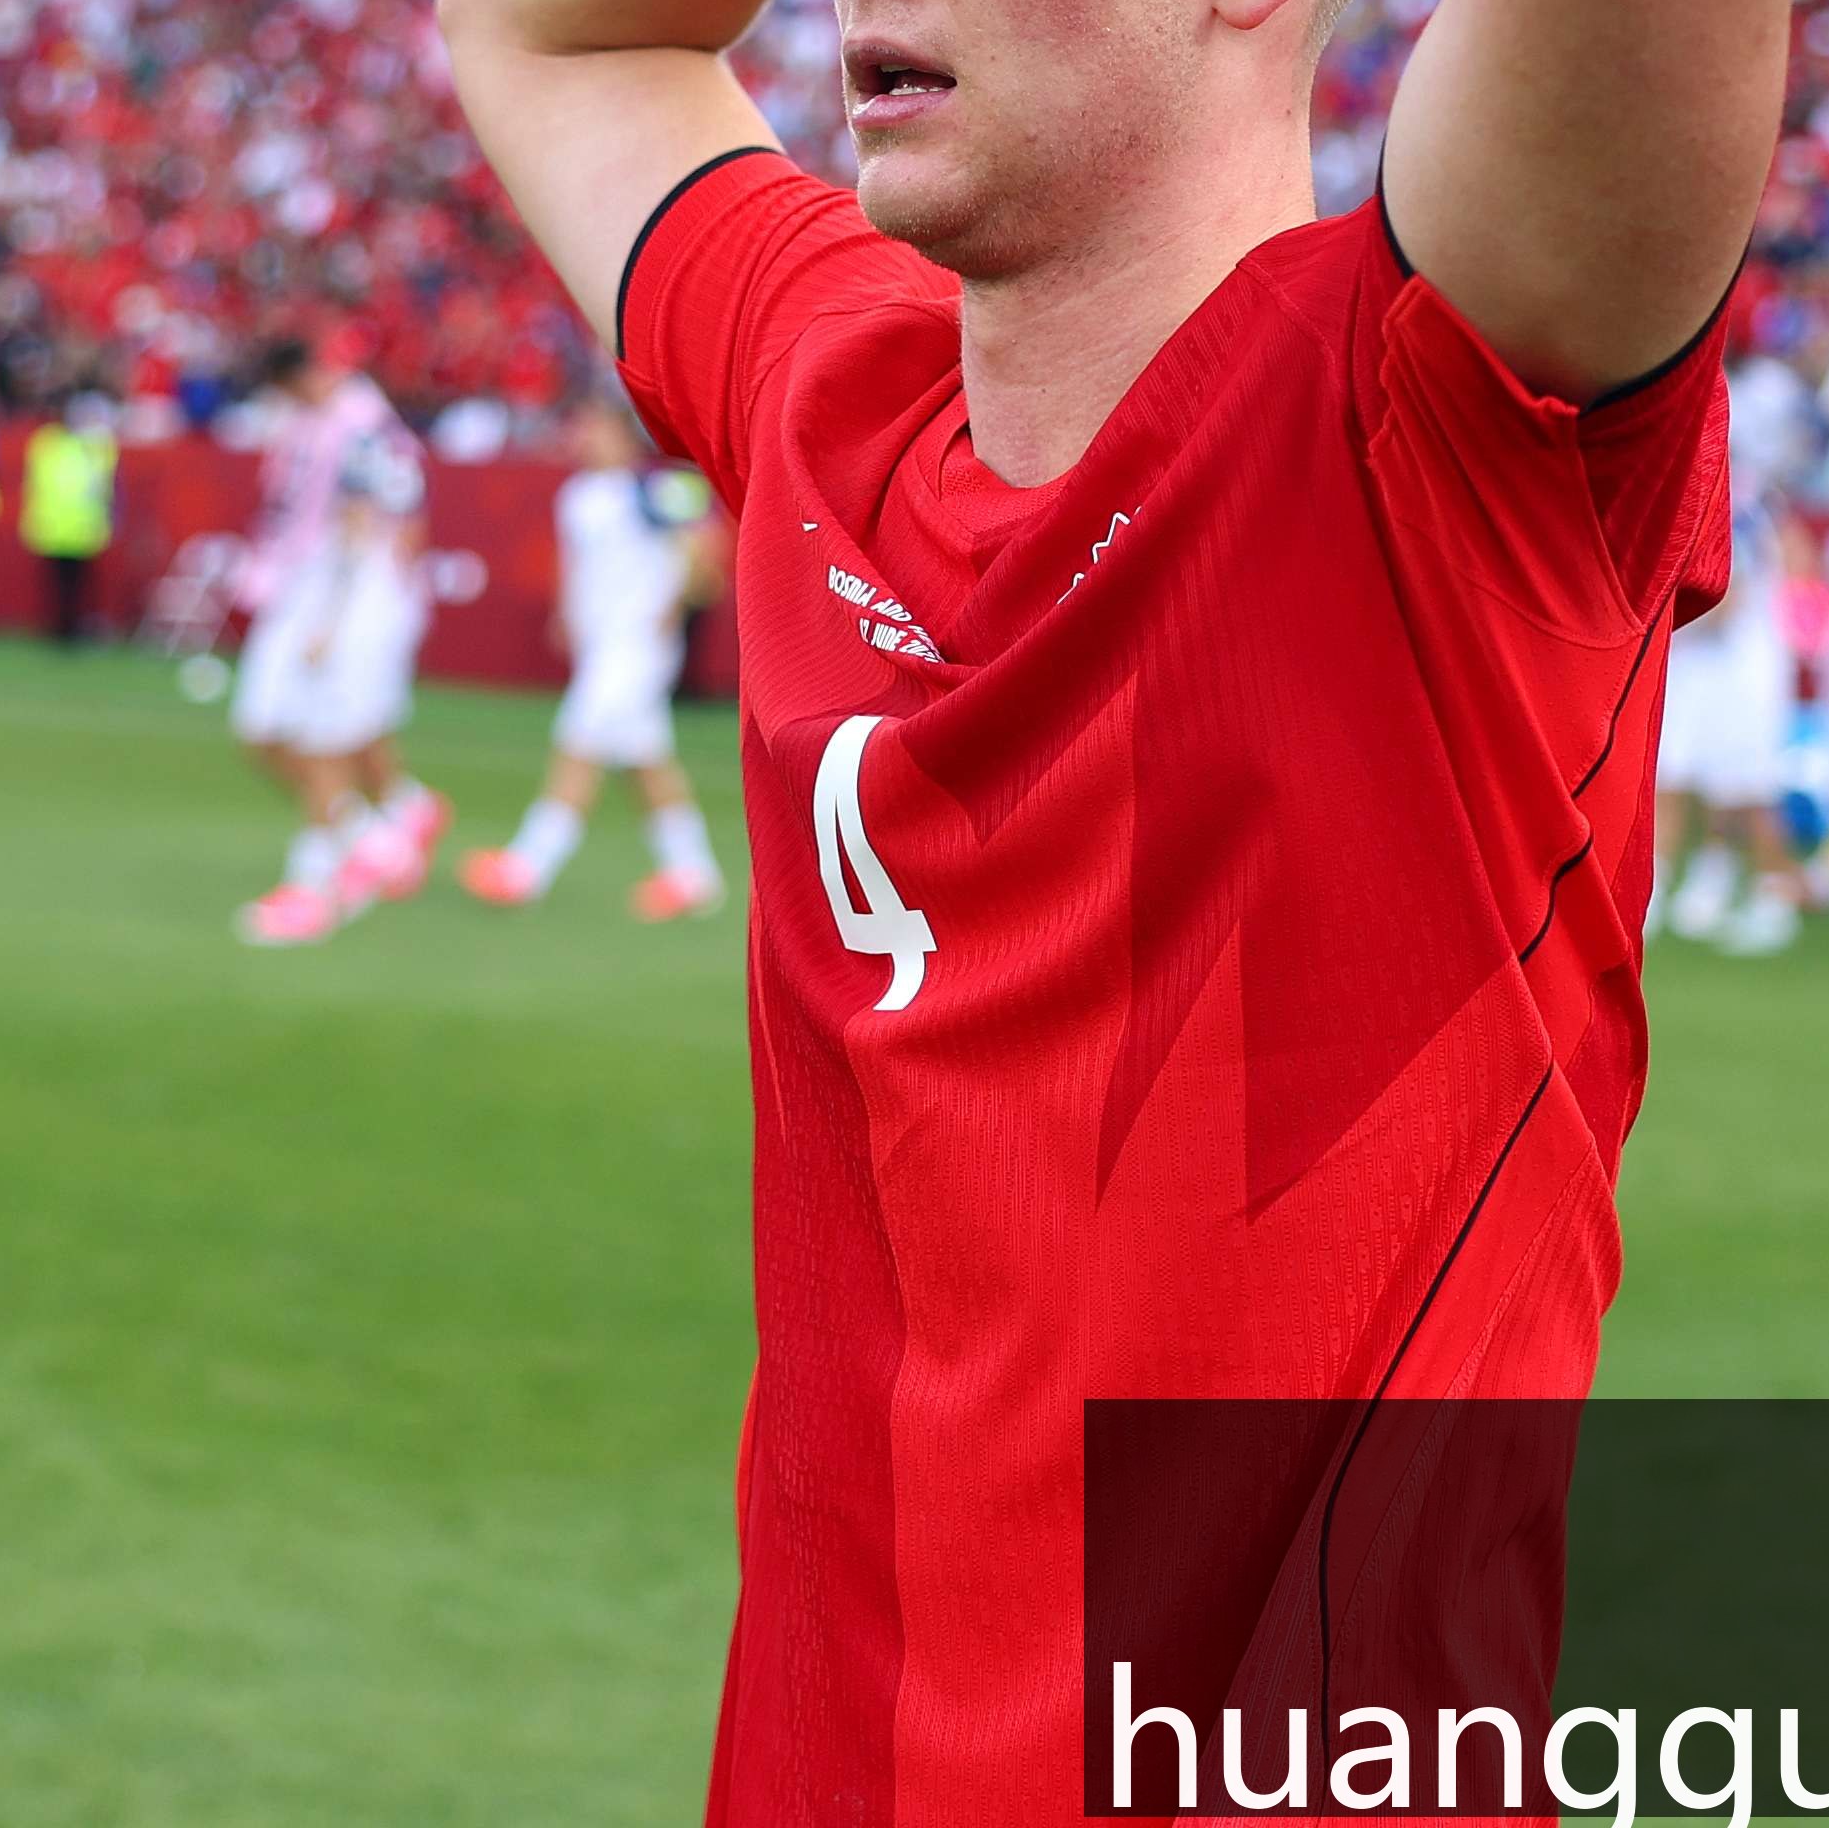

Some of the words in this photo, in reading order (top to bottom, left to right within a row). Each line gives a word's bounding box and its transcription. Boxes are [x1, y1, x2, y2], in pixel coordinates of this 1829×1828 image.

[828, 564, 877, 608] BOSNIA
[870, 597, 913, 623] AND
[870, 621, 909, 653] JUNE
[898, 638, 940, 664] 202
[813, 715, 937, 1011] 4
